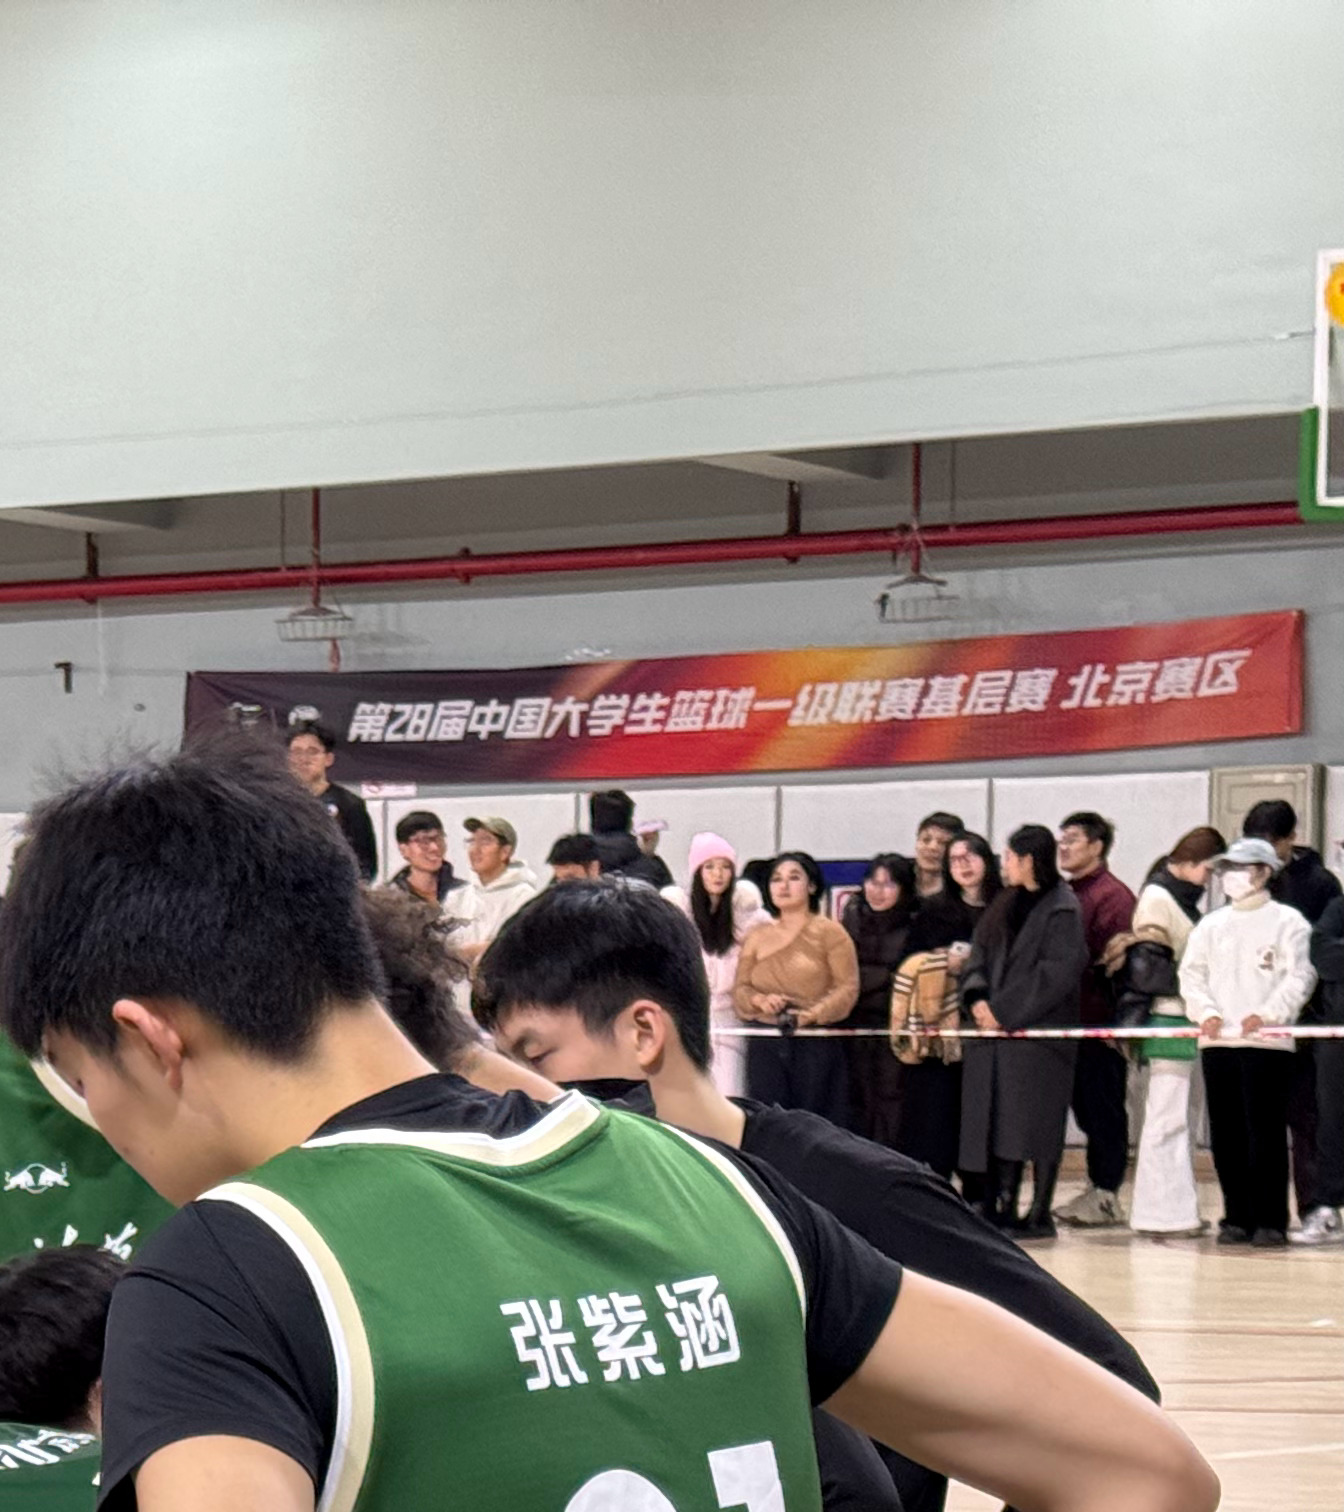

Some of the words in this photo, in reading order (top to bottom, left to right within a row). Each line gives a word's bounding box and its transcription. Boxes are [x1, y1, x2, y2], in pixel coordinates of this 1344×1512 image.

[347, 667, 1058, 743] 第28届中国大学生篮球一级联赛基层赛
[1059, 648, 1253, 709] 北京赛区
[500, 1275, 741, 1391] 张紫涵
